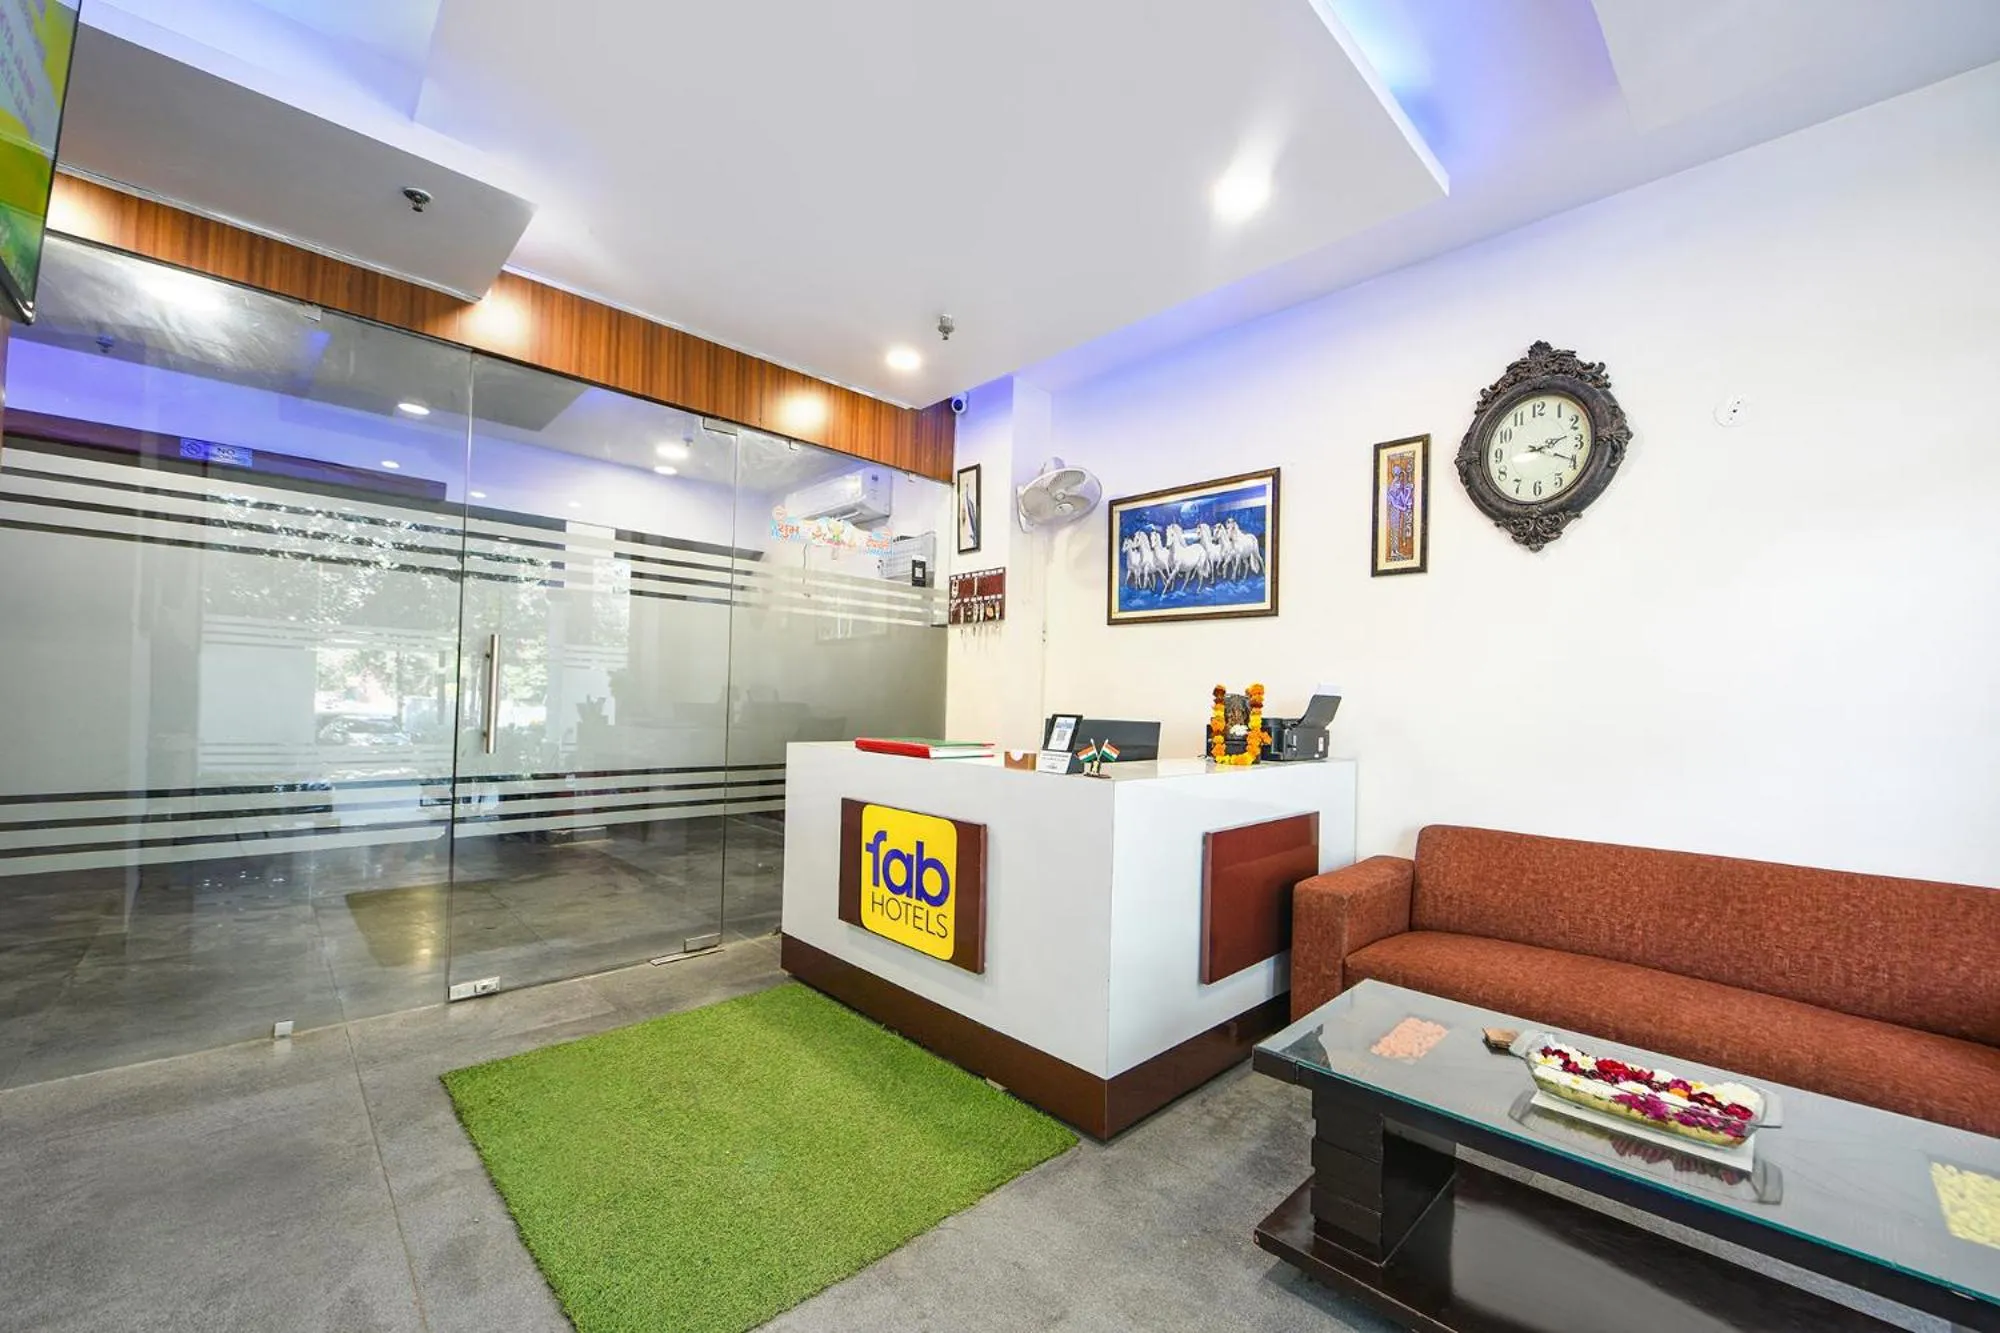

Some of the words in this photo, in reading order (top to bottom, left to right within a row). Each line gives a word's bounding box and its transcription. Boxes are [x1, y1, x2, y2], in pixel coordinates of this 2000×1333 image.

[1532, 401, 1546, 418] 12
[1557, 402, 1562, 418] 1
[1514, 411, 1524, 427] 11
[1569, 414, 1579, 430] 2
[1499, 428, 1513, 444] 10
[1574, 434, 1584, 450] 3
[1494, 448, 1503, 464] 9
[1497, 465, 1508, 481] 8
[1554, 472, 1563, 488] 5
[1513, 479, 1522, 494] 7
[1532, 480, 1542, 496] 6
[865, 830, 950, 907] fab
[872, 892, 948, 938] HOTELS
